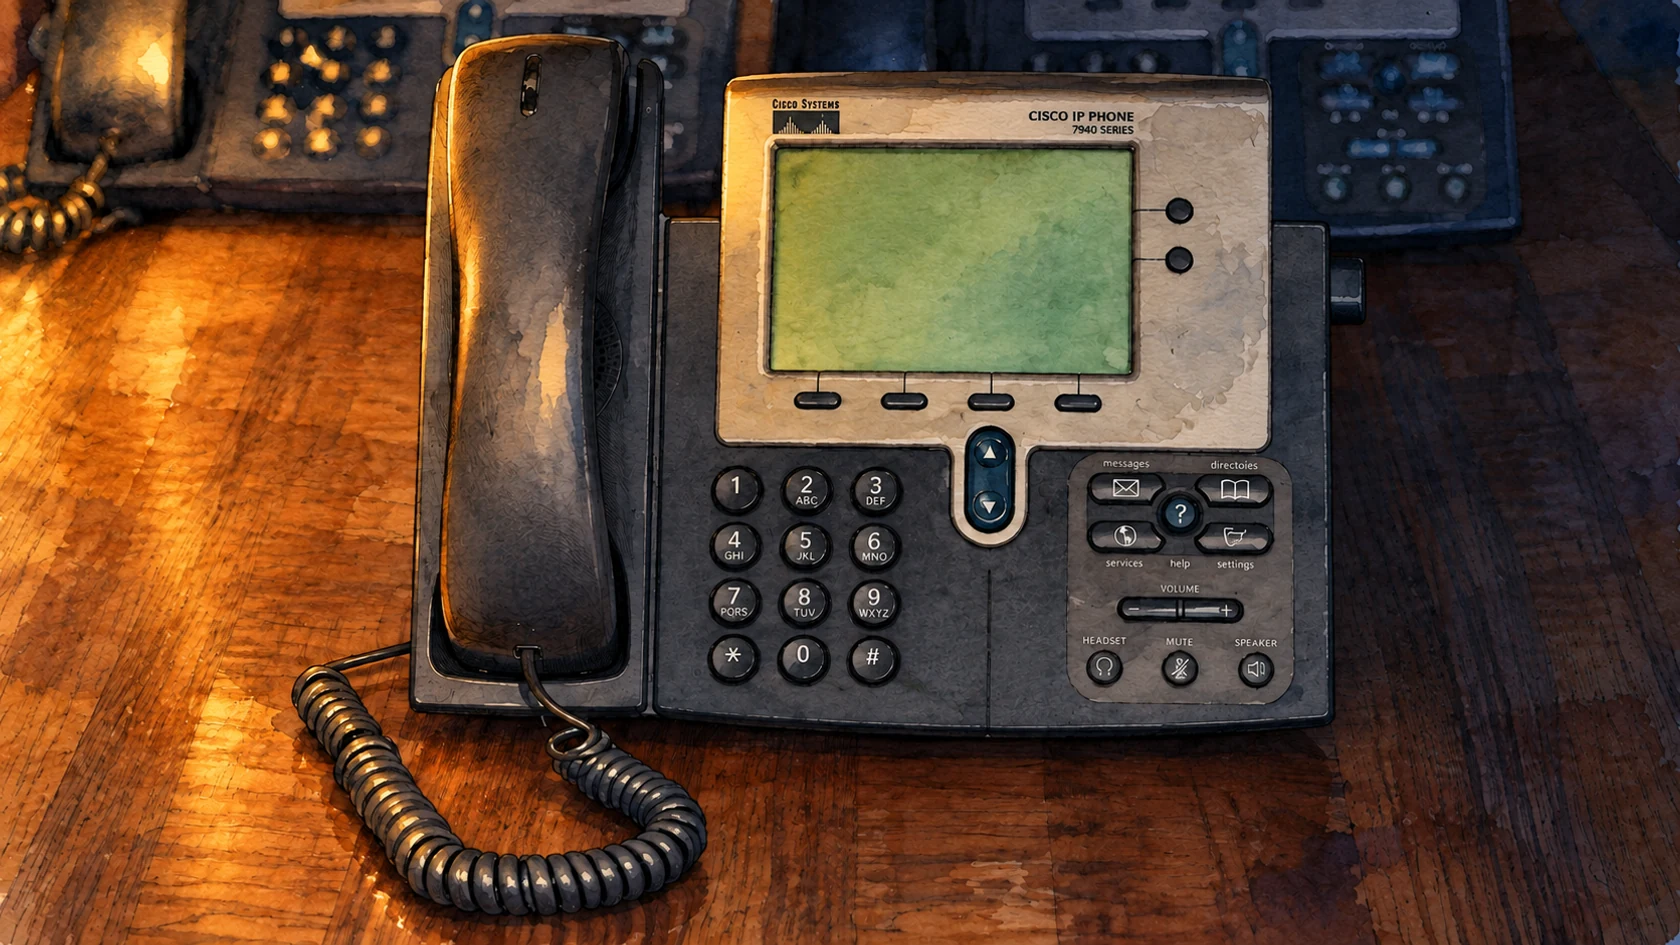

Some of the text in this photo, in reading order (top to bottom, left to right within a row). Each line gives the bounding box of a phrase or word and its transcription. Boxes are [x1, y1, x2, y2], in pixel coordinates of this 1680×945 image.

[1028, 111, 1134, 121] CISCO IP PHONE
[1073, 125, 1134, 134] 7940 SERIES
[1103, 460, 1149, 470] messages
[1211, 461, 1258, 470] directoies
[732, 476, 739, 493] 1
[801, 476, 812, 493] 2
[870, 477, 881, 494] 3
[796, 496, 818, 505] ABC
[866, 497, 885, 505] DEF
[728, 531, 741, 548] 4
[801, 532, 811, 548] 5
[869, 533, 880, 549] 6
[725, 552, 743, 560] GHI
[796, 553, 815, 561] JKL
[862, 553, 887, 561] MNO
[1106, 559, 1143, 568] services
[1170, 559, 1190, 569] help
[1217, 560, 1254, 570] settings
[1161, 585, 1199, 593] VOLUME
[728, 587, 740, 604] 7
[799, 588, 810, 605] 8
[868, 588, 880, 605] 9
[794, 609, 815, 617] TUV
[859, 609, 889, 618] WXYZ
[1083, 637, 1126, 645] HEADSET
[1166, 638, 1193, 646] MUTE
[1235, 639, 1277, 647] SPEAKER
[797, 645, 809, 663] 0
